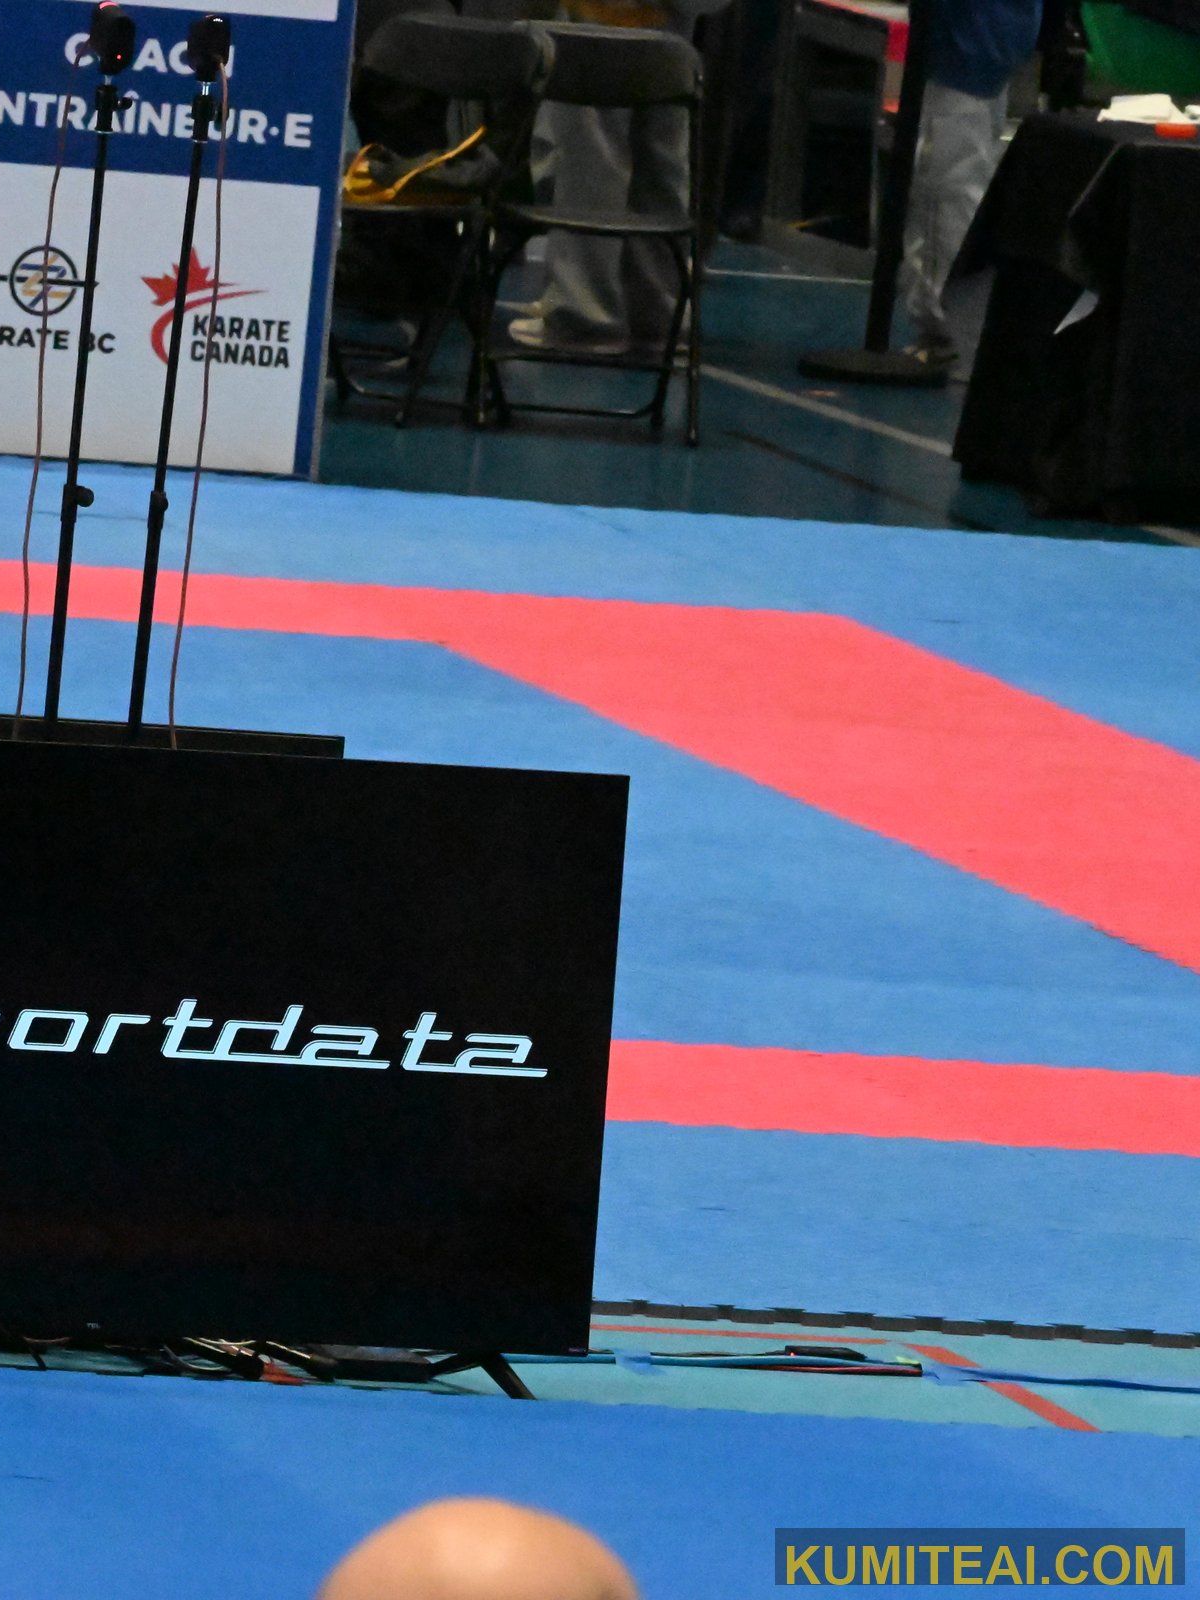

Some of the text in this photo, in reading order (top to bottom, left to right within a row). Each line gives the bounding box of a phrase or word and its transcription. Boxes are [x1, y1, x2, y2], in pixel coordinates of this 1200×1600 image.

[65, 32, 235, 78] CAC
[192, 314, 290, 342] KARATE
[190, 340, 289, 368] CANADA
